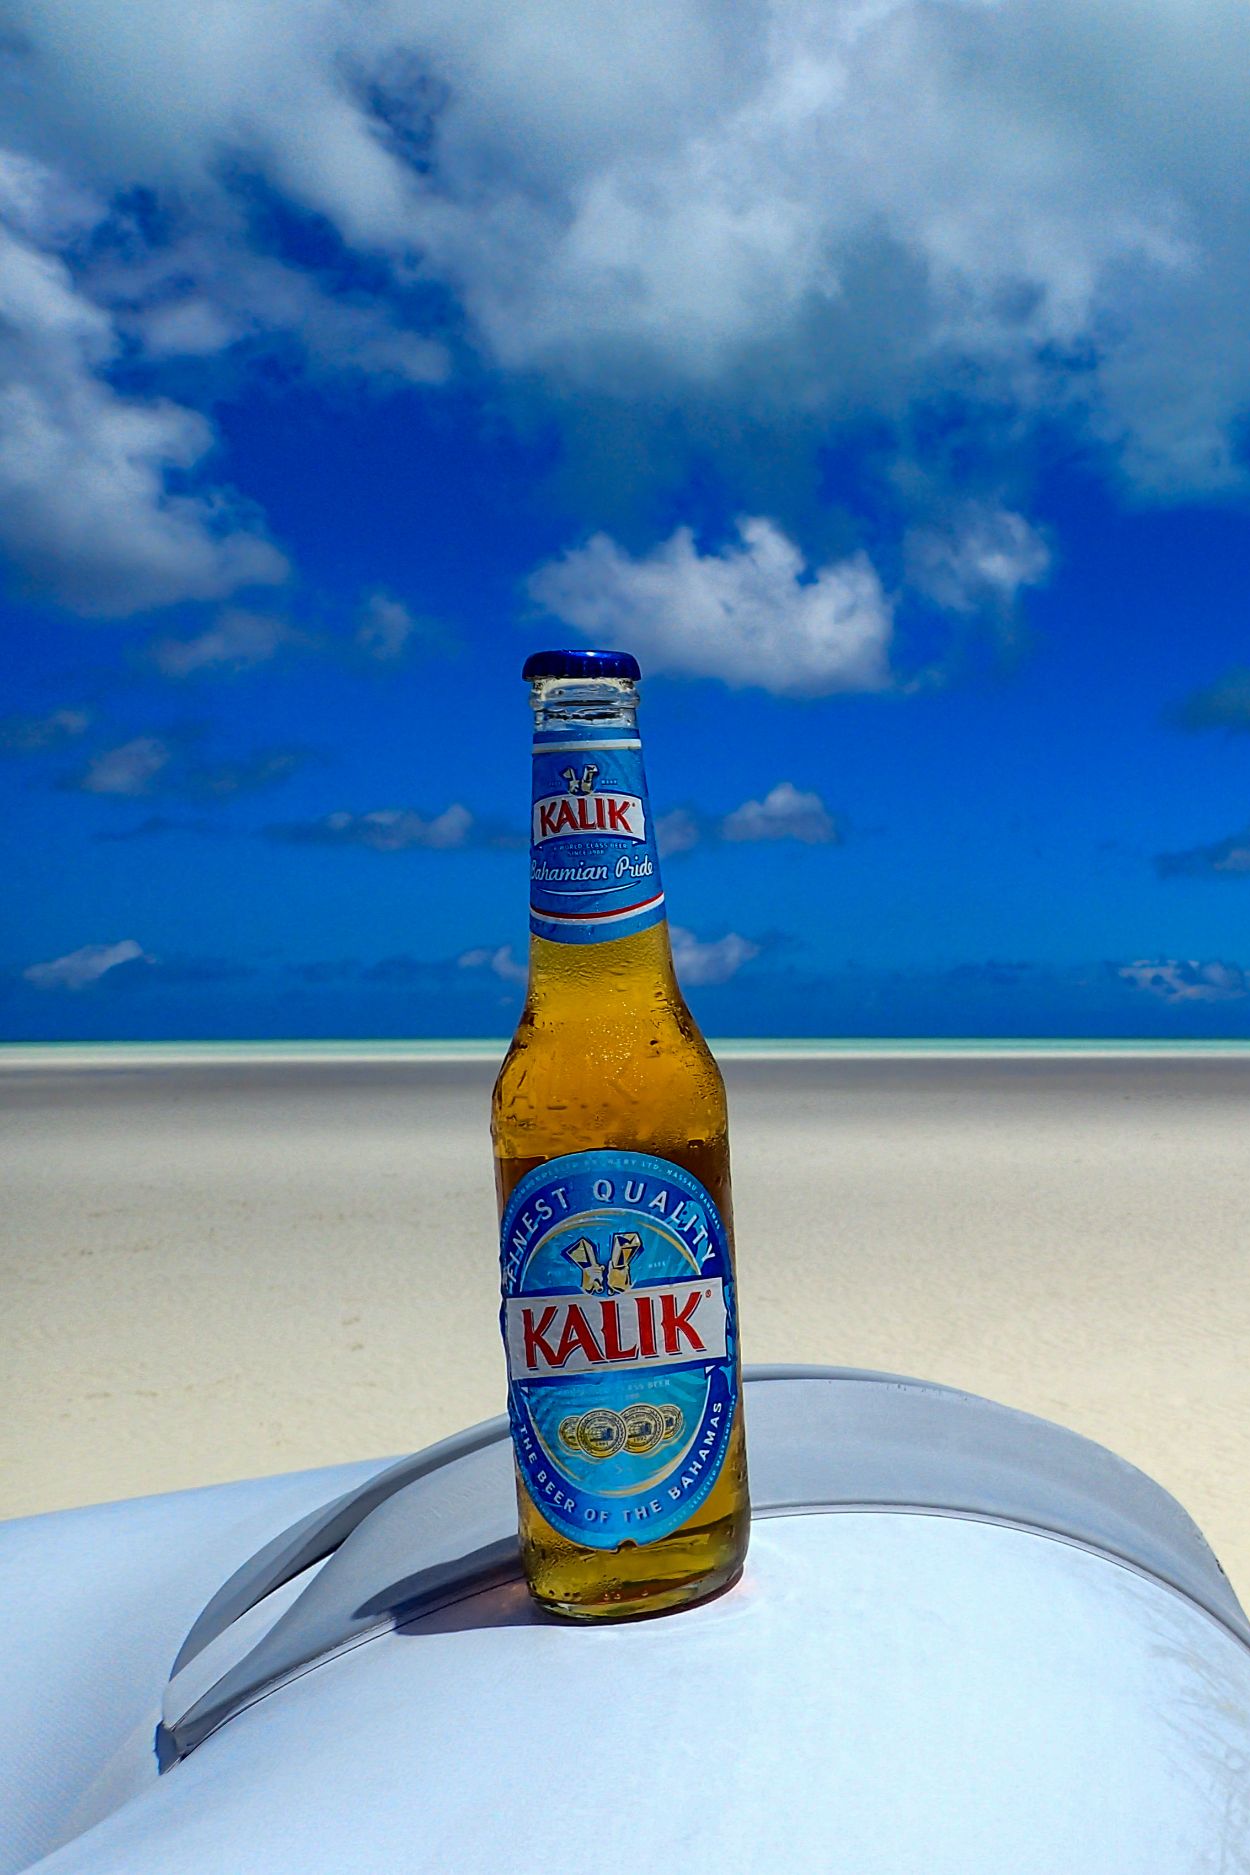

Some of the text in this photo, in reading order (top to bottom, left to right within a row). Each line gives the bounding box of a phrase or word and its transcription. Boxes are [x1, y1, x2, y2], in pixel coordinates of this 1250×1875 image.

[540, 798, 633, 837] KALIK
[615, 854, 653, 878] Pride
[507, 1187, 567, 1283] FINEST
[593, 1179, 716, 1263] QUALITY
[521, 1291, 707, 1370] KALIK
[520, 1424, 538, 1464] THE
[537, 1470, 575, 1513] BEER
[584, 1508, 609, 1524] OF
[622, 1499, 662, 1523] THE
[667, 1402, 722, 1500] BAHAMAS
